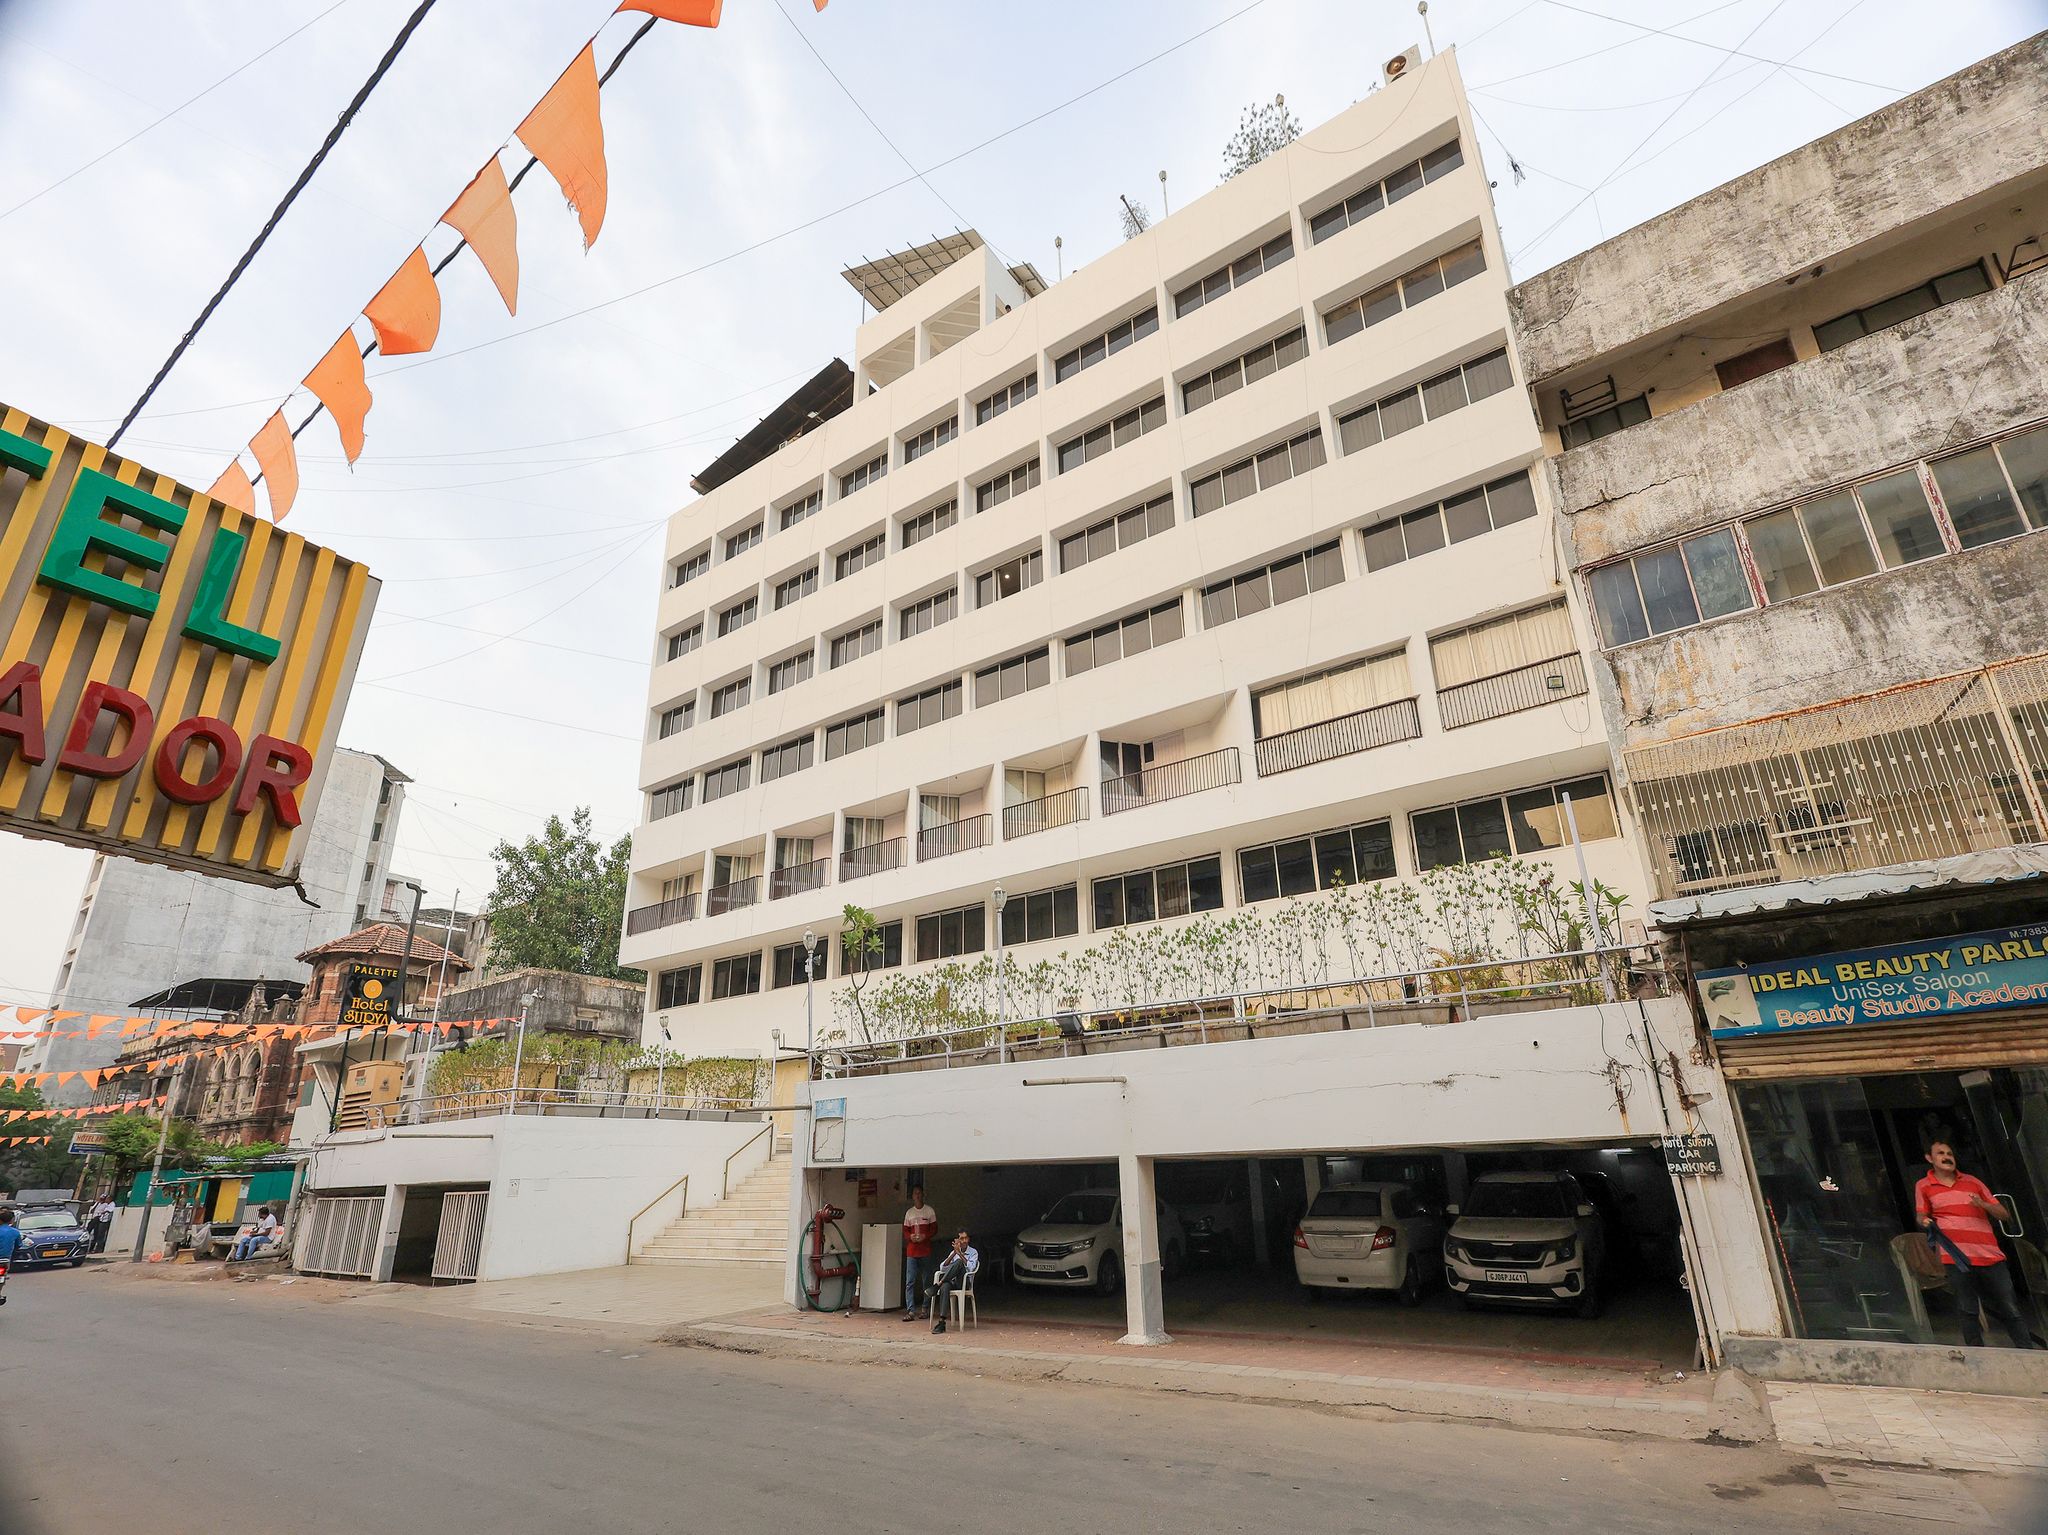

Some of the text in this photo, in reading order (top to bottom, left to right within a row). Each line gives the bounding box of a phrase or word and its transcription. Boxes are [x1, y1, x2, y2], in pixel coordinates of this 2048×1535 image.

[0, 429, 281, 666] EL
[2009, 926, 2048, 939] M:7383
[354, 965, 399, 978] PALETTE
[1749, 969, 1831, 993] IDEAL
[1834, 948, 1952, 983] BEAUTY
[1831, 970, 1990, 1002] UniSex Saloon
[350, 997, 389, 1011] Hotel
[1774, 1003, 1855, 1028] Beauty
[1861, 994, 1941, 1017] Studio
[343, 1009, 389, 1025] SURYA
[1687, 1138, 1714, 1148] SURYA
[1678, 1149, 1701, 1159] CAR
[1668, 1162, 1717, 1173] PARKING
